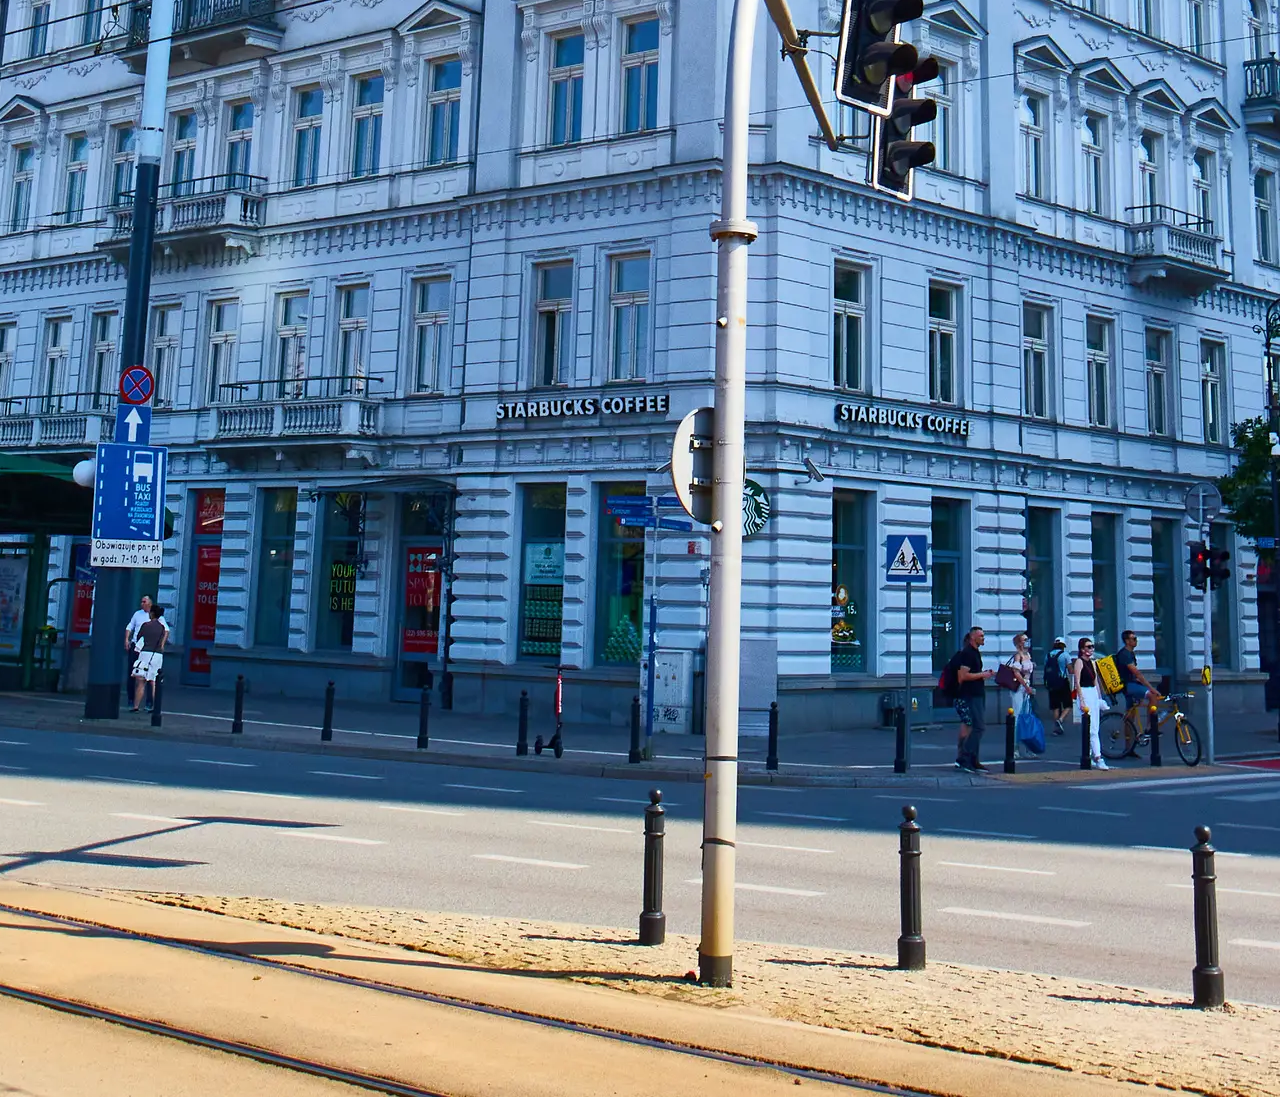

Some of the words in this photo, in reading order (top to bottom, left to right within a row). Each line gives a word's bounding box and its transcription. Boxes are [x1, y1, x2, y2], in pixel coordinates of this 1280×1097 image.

[496, 399, 595, 419] STARBUCKS
[601, 395, 667, 414] COFFEE
[840, 404, 923, 429] STARBUCKS
[927, 414, 975, 436] COFFEE
[135, 483, 151, 492] BUS
[134, 492, 151, 501] TAXI
[100, 554, 119, 565] godz.
[142, 555, 160, 564] 14-19
[330, 580, 355, 594] FUTU
[197, 594, 207, 603] TO
[208, 595, 218, 604] LE
[329, 597, 338, 610] IS
[341, 597, 353, 611] HE
